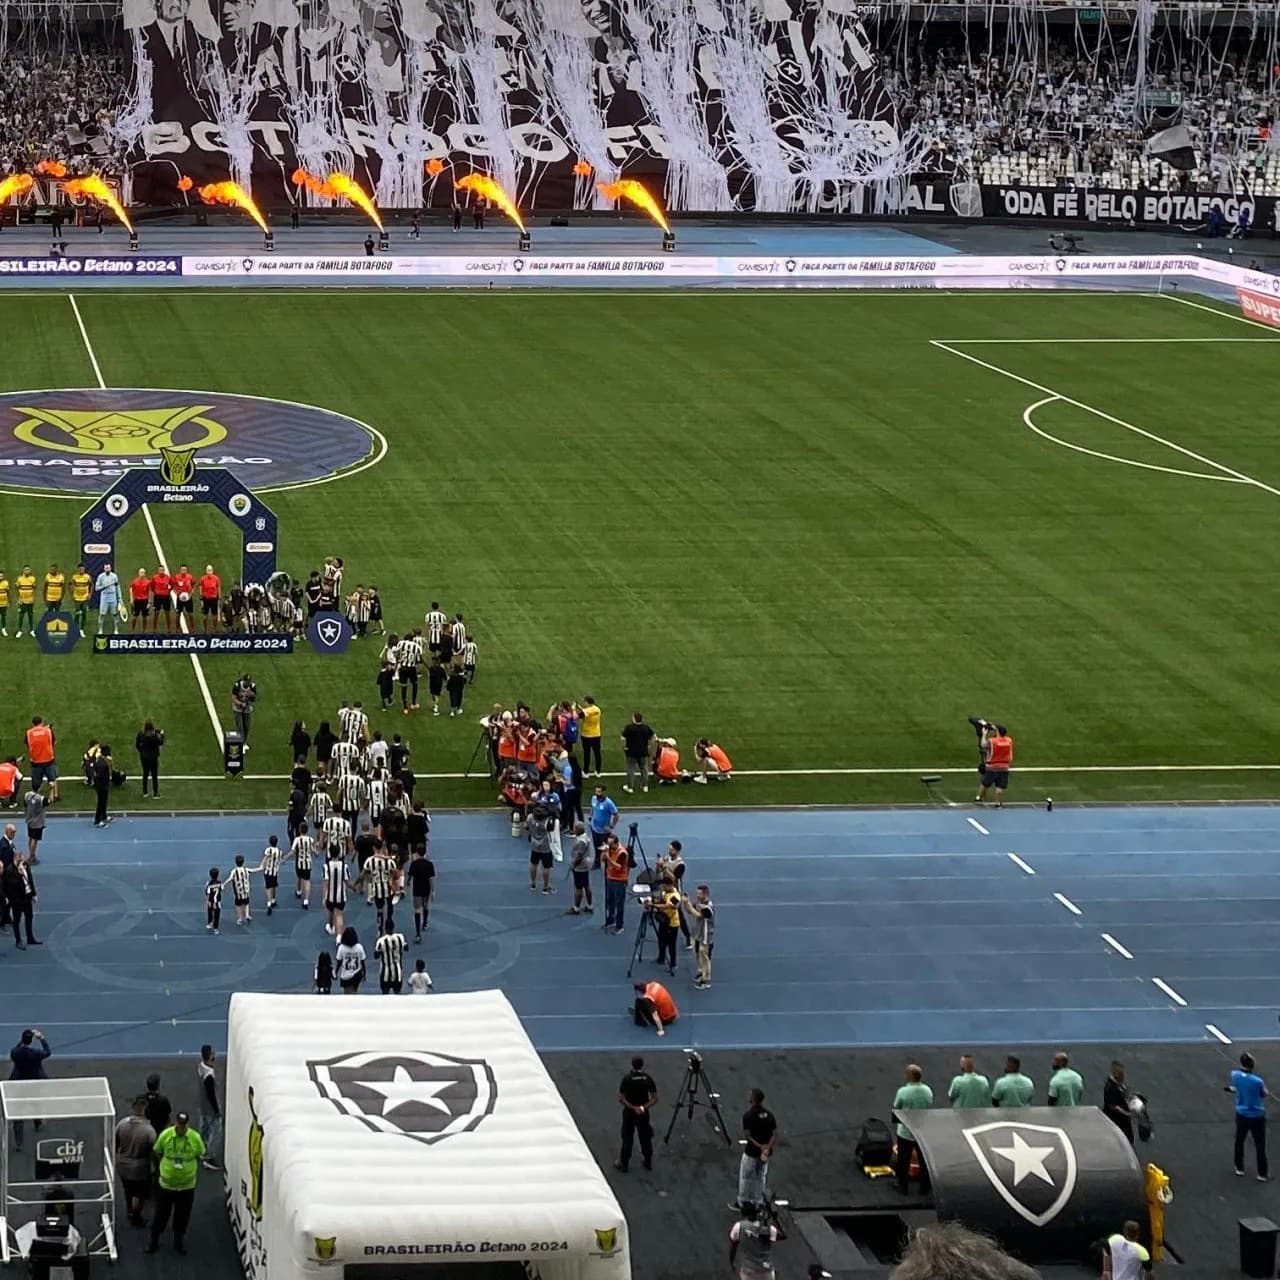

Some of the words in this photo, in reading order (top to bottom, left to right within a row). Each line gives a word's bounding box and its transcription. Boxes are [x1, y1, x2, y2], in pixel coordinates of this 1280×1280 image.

[1000, 189, 1047, 216] ODA
[84, 258, 133, 272] Betano
[136, 260, 177, 272] 2024
[350, 260, 393, 271] BOTAFOGO
[622, 260, 664, 271] BOTAFOGO
[893, 261, 936, 271] BOTAFOGO
[147, 484, 210, 492] BRASILEIRÃO
[163, 493, 194, 502] Betano
[109, 637, 207, 650] BRASILEIRÃO
[210, 638, 251, 650] Betano
[253, 639, 288, 649] 2024
[56, 1140, 85, 1157] cbf
[364, 1241, 475, 1255] BRASILEIRÃO
[479, 1240, 527, 1254] Betano
[530, 1240, 569, 1252] 2024
